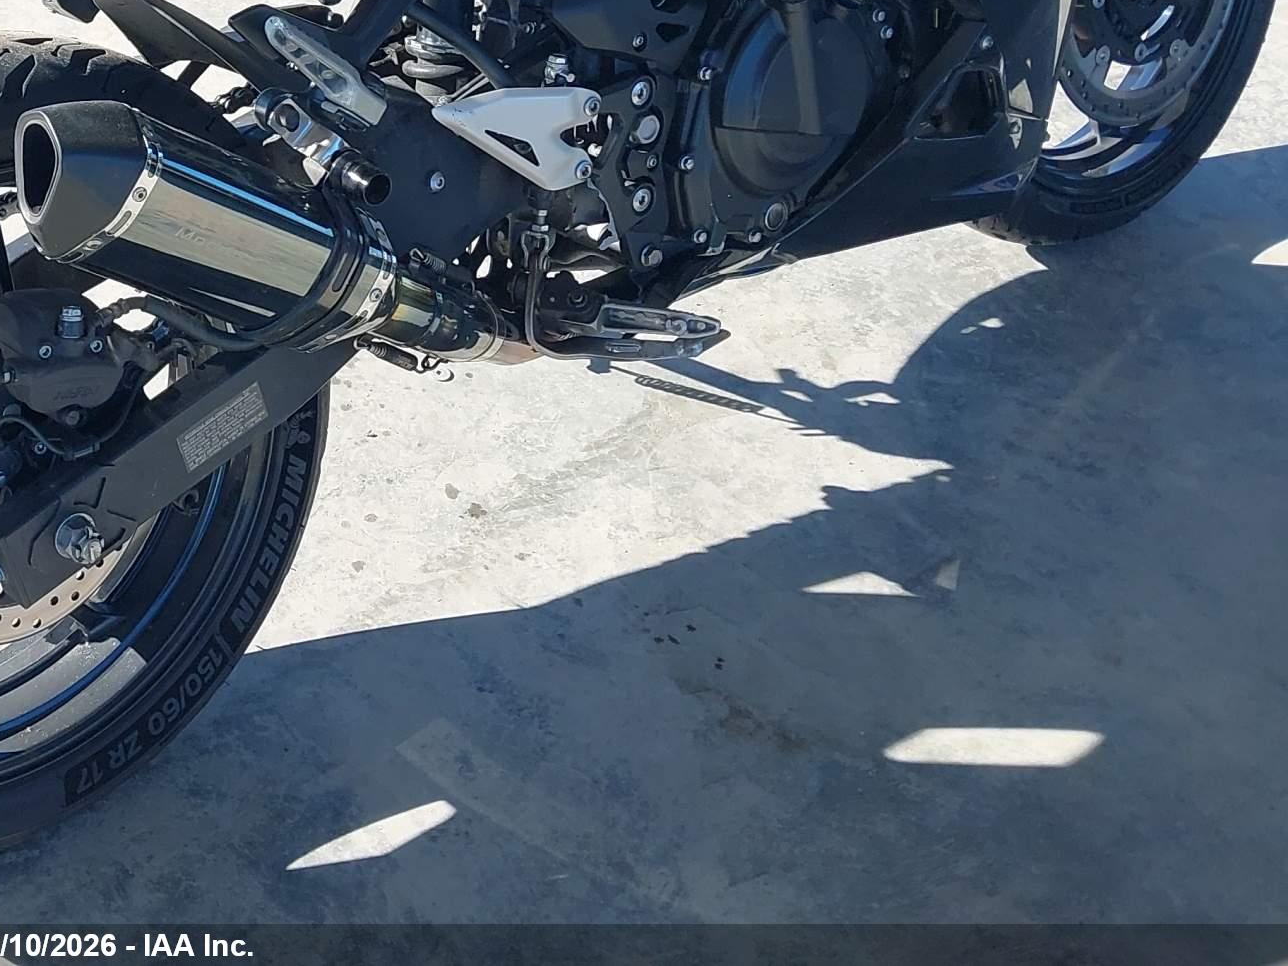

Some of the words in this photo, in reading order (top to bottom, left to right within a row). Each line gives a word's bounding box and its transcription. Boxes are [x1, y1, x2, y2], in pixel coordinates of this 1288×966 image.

[231, 453, 308, 634] MICHELIN
[147, 646, 225, 734] 150/60
[76, 758, 105, 794] 17
[108, 733, 143, 771] ZR
